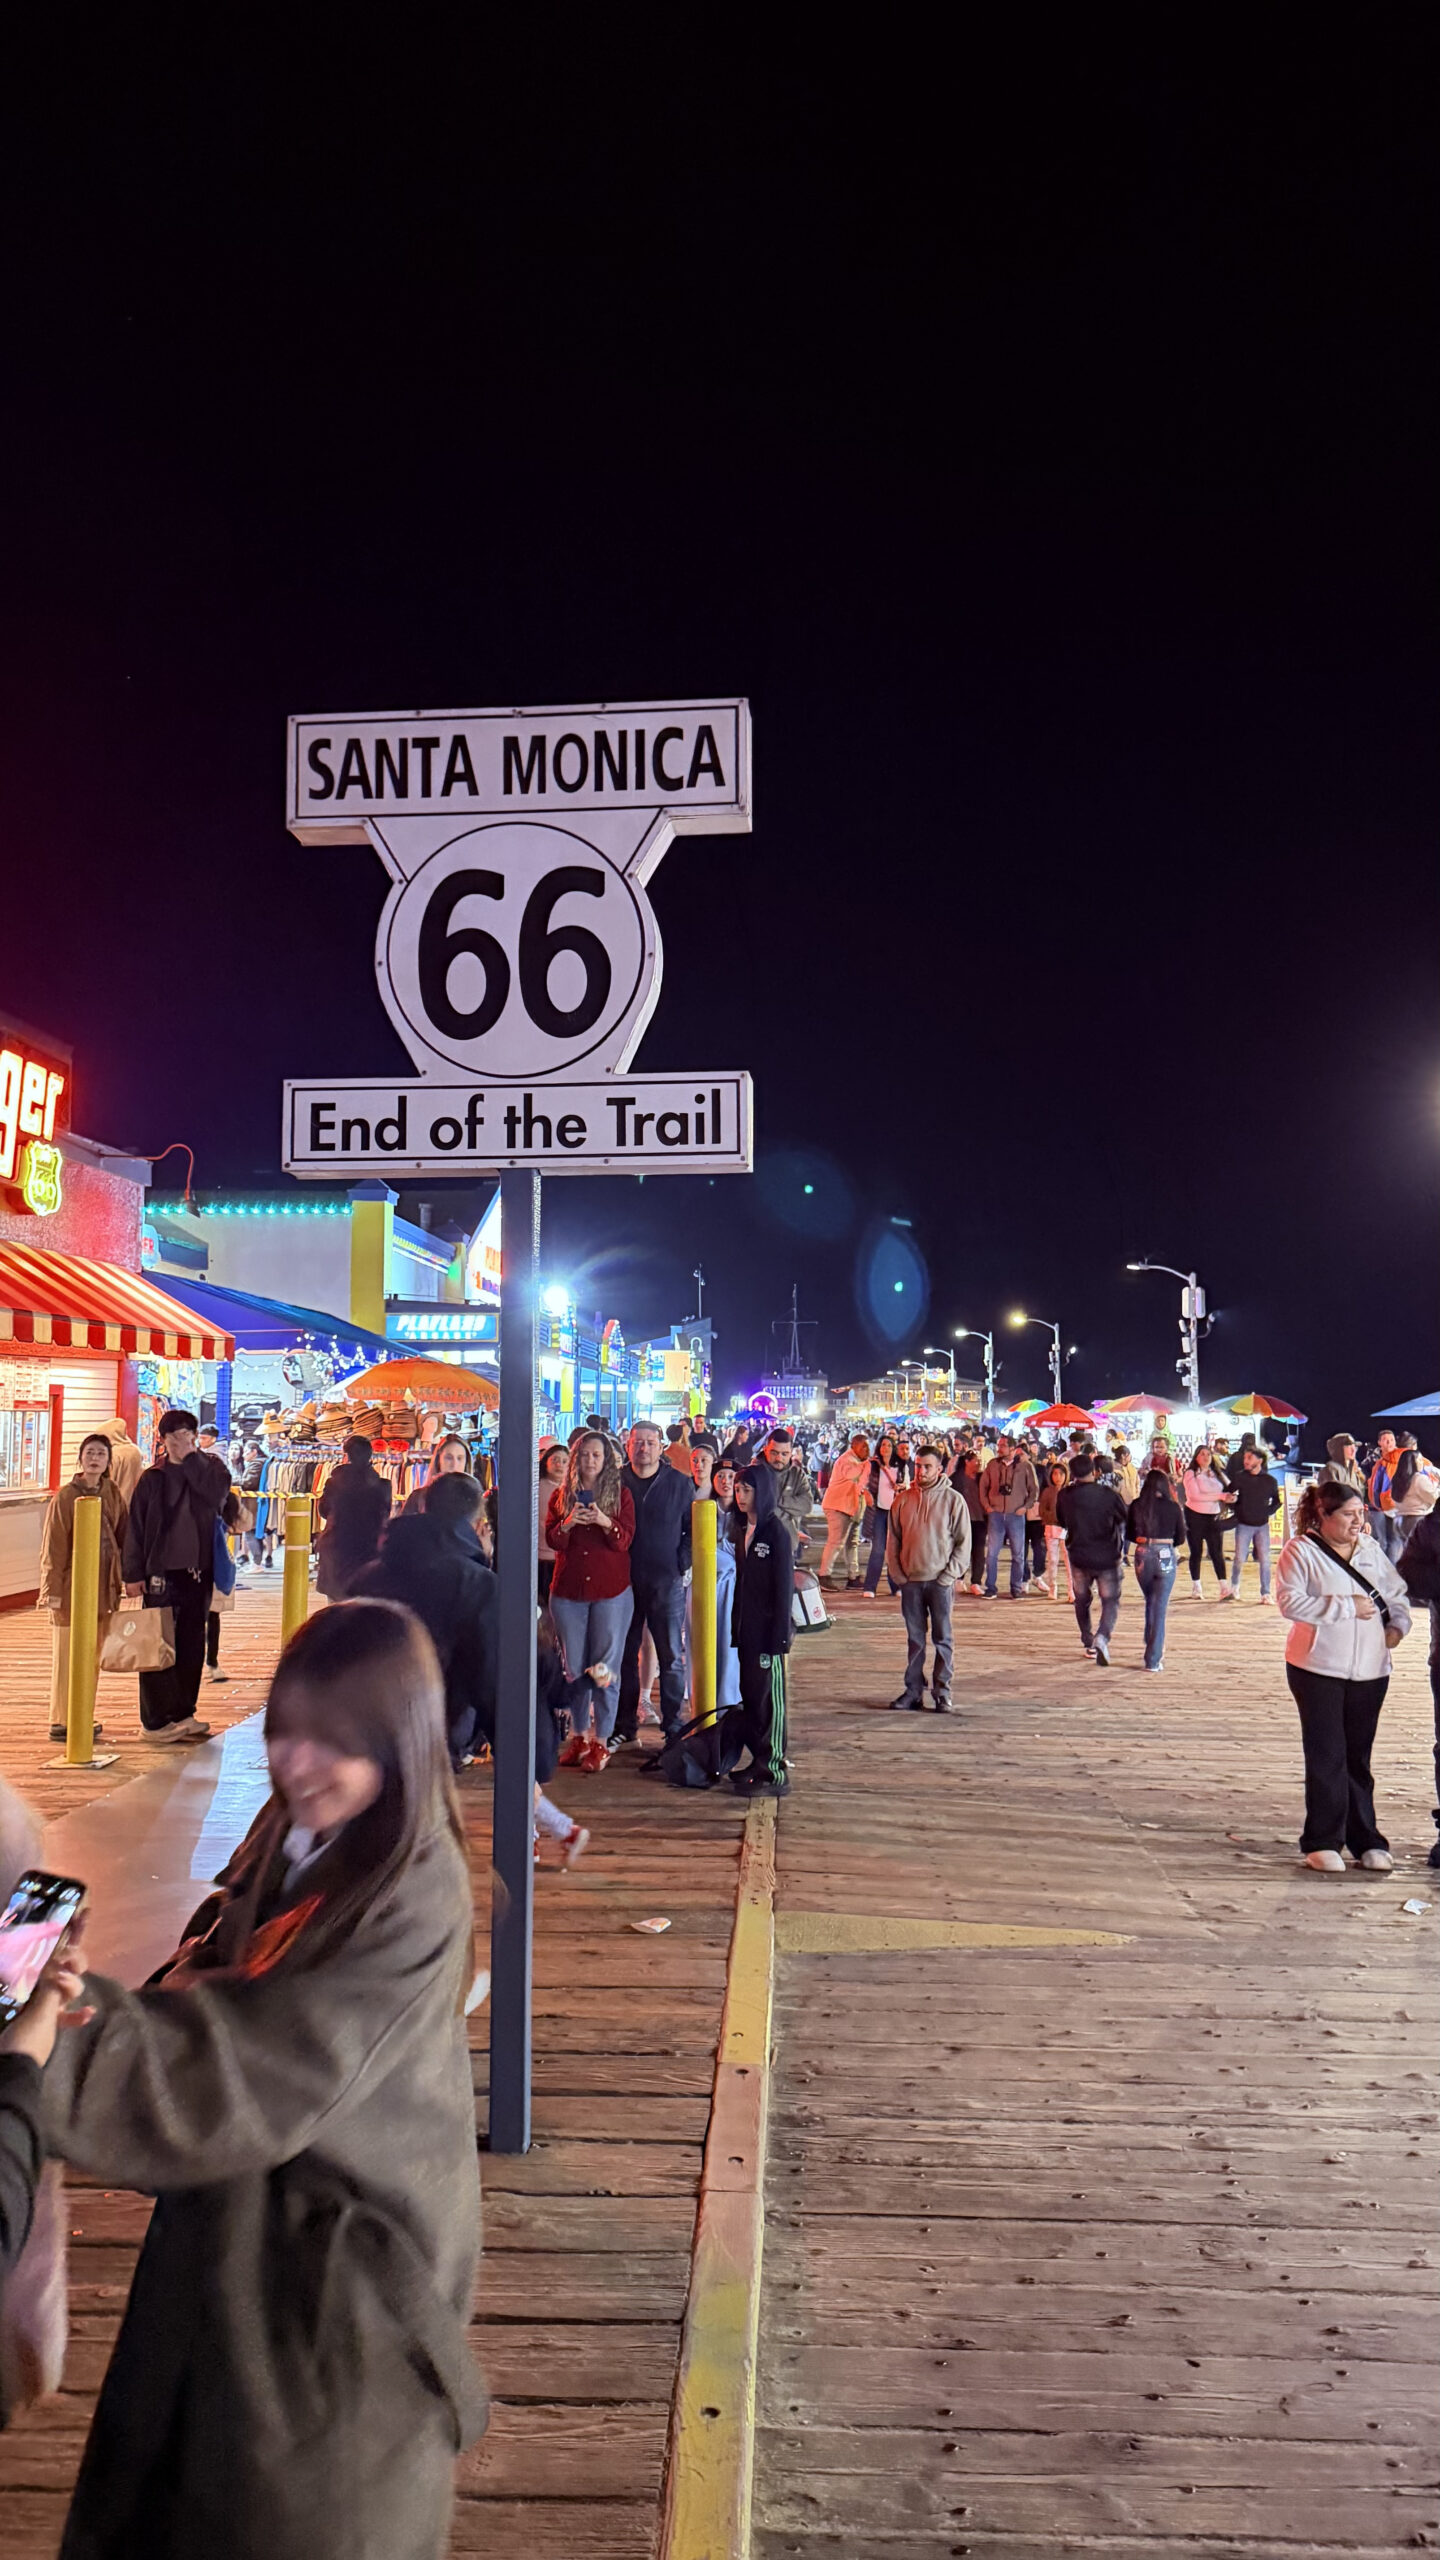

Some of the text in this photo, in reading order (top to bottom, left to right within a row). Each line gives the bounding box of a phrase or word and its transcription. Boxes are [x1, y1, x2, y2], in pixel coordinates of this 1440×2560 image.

[307, 724, 726, 800] SANTA MONICA
[418, 865, 612, 1041] 66
[309, 1088, 722, 1152] End of the Trail
[396, 1315, 487, 1332] PLAYLAND
